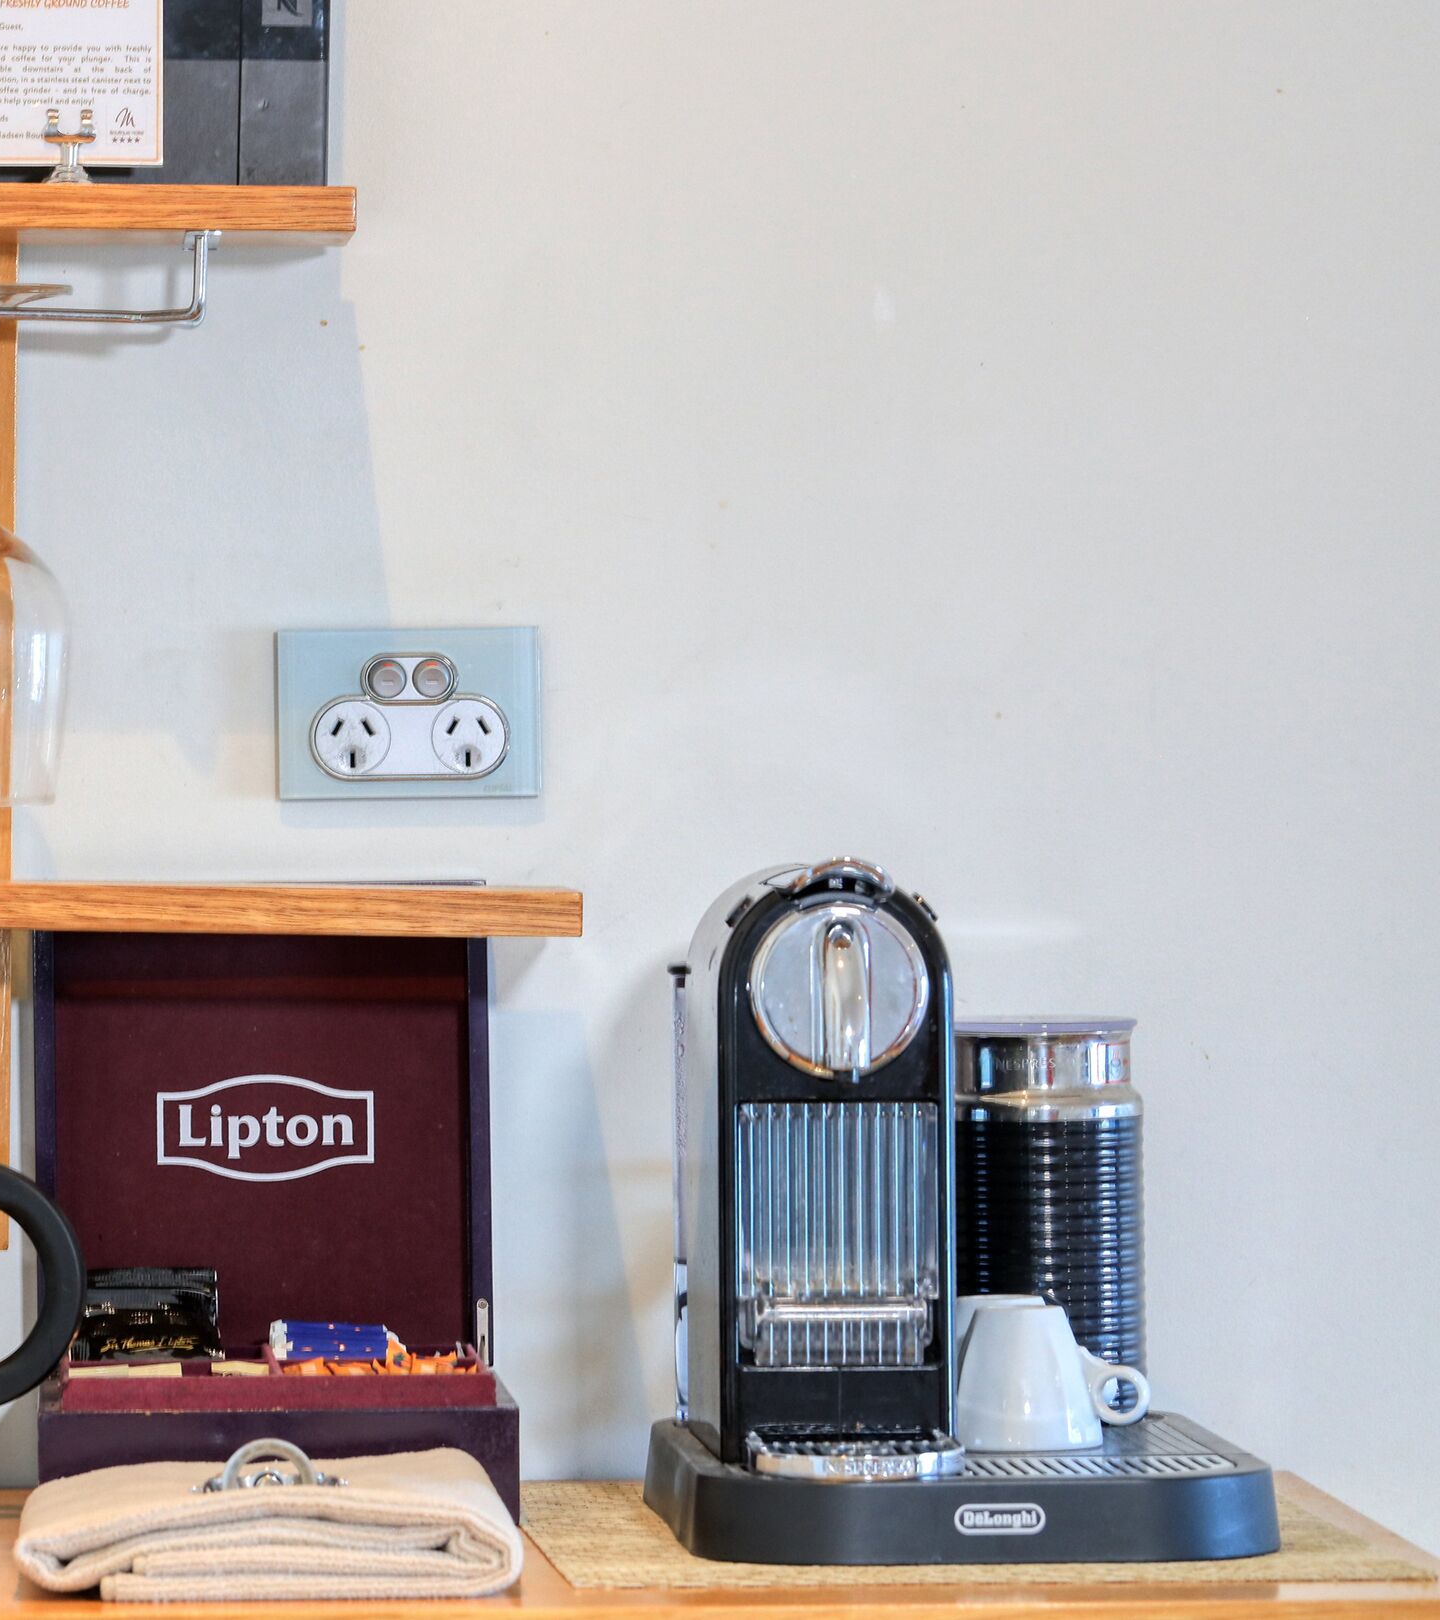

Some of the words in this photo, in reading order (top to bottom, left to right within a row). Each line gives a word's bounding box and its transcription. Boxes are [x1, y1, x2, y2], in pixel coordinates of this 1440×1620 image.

[0, 0, 40, 8] FRESHLY
[44, 0, 87, 8] GROUND
[91, 0, 130, 8] COFFEE
[12, 44, 37, 53] happy
[53, 44, 82, 53] provide
[126, 44, 152, 53] freshly
[126, 55, 140, 63] This
[22, 65, 63, 73] downstairs
[115, 65, 133, 73] back
[21, 75, 29, 83] in
[37, 75, 69, 83] stainless
[71, 75, 90, 83] steel
[23, 86, 51, 95] grinder
[4, 96, 21, 106] help
[23, 96, 53, 106] yourself
[55, 97, 70, 105] and
[71, 97, 95, 106] enjoy!
[178, 1103, 355, 1160] Lipton
